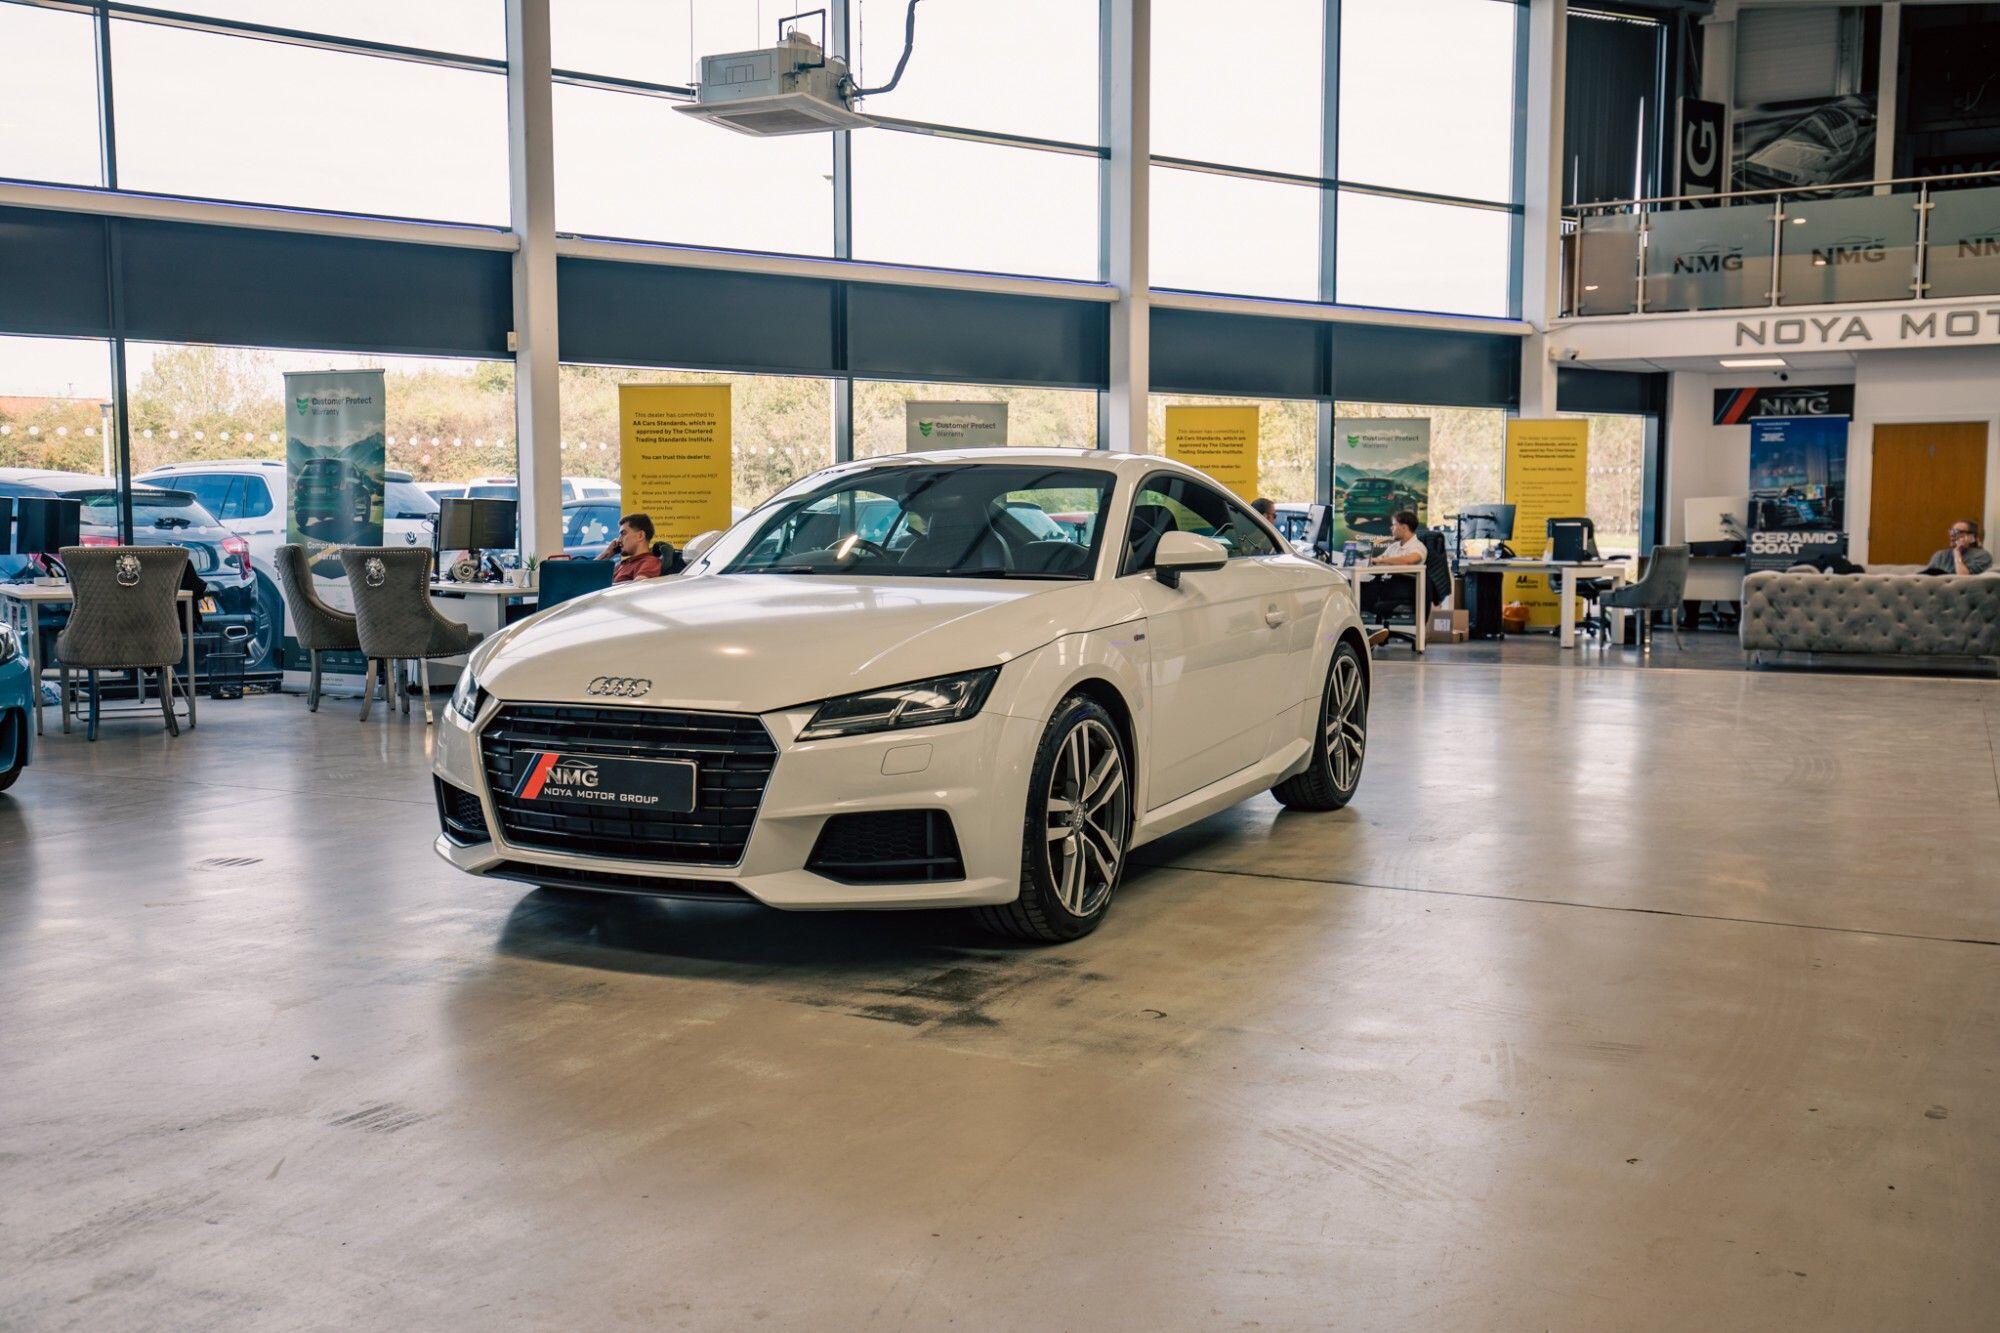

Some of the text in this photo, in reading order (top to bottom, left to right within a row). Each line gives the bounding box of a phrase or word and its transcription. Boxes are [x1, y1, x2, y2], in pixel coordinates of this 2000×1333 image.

[1673, 253, 1743, 274] NMG
[1811, 247, 1886, 266] NMG
[1736, 316, 1873, 346] NOYA
[345, 396, 372, 404] Protect
[1760, 397, 1829, 415] NMG
[1752, 532, 1838, 544] CERAMIC
[1752, 544, 1803, 554] COAT
[546, 767, 598, 787] NMG
[544, 788, 658, 804] NOYA MOTOR GROUP
